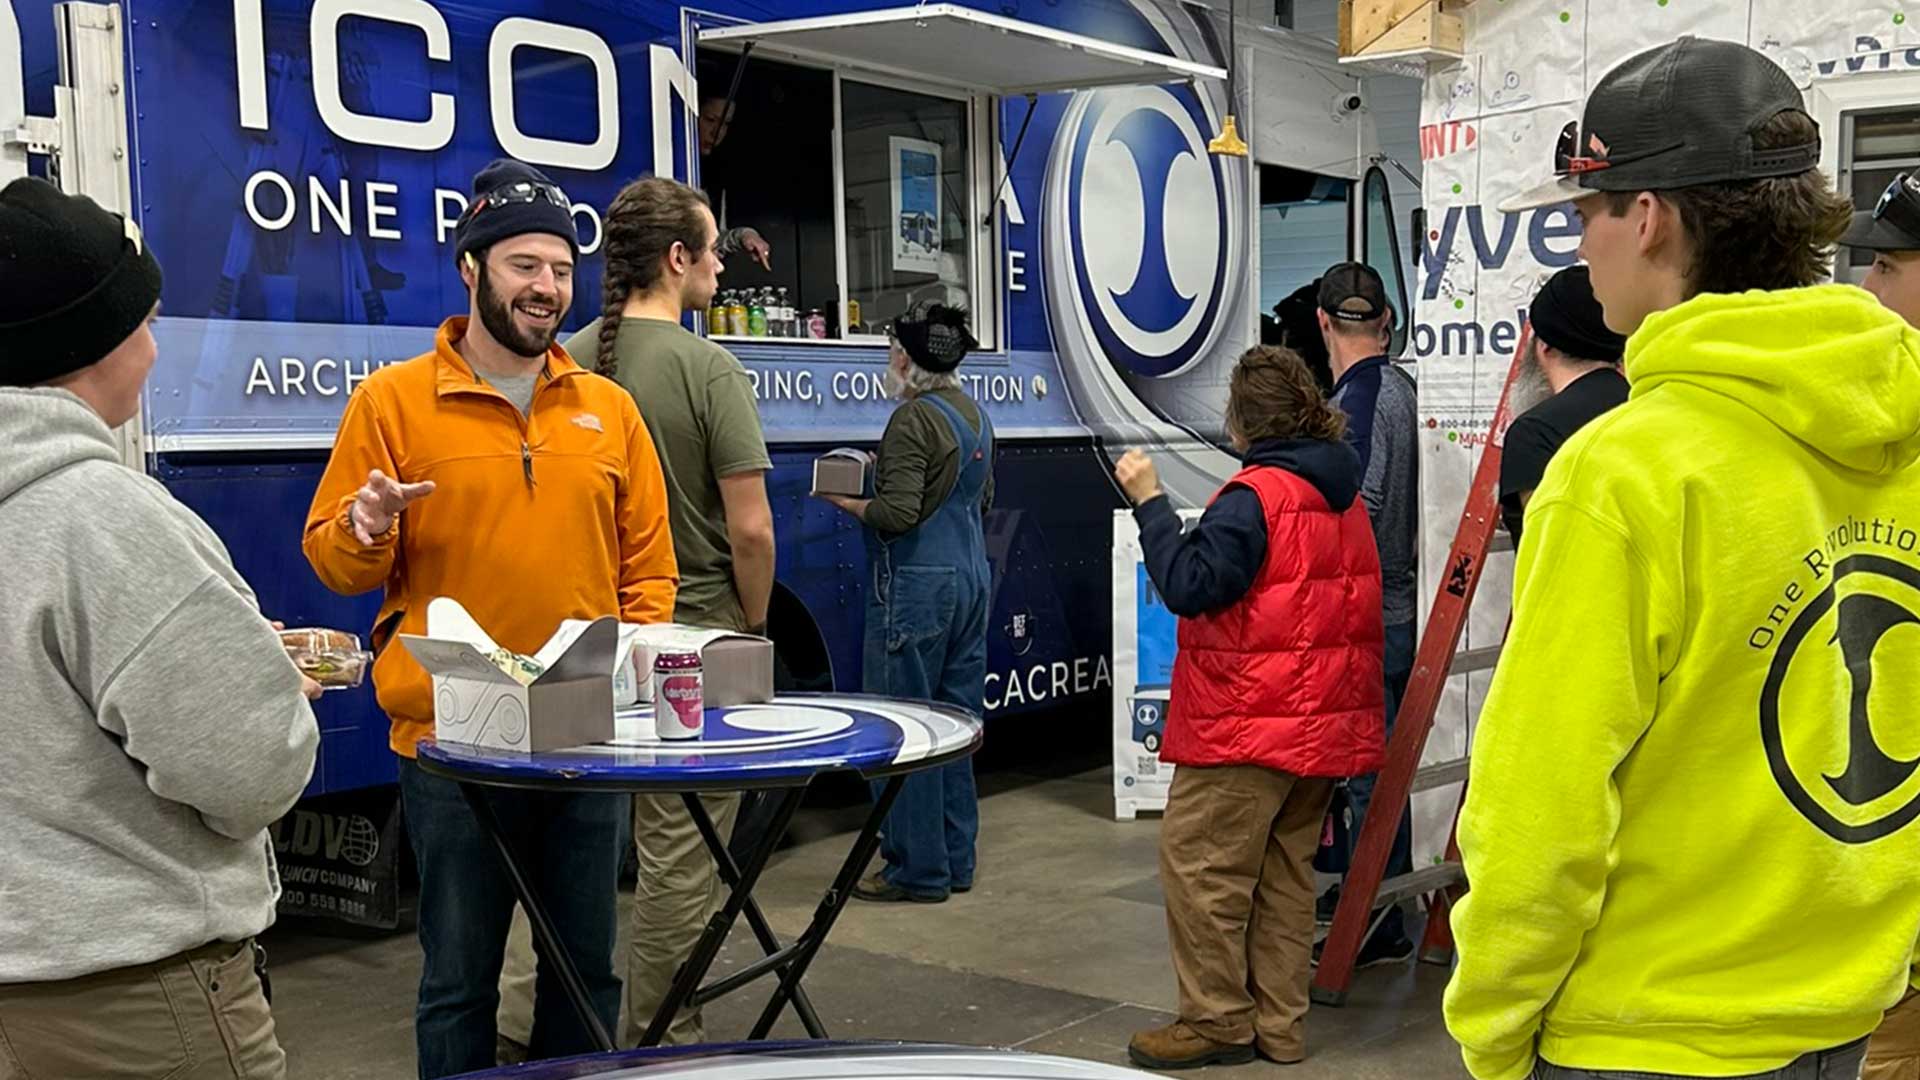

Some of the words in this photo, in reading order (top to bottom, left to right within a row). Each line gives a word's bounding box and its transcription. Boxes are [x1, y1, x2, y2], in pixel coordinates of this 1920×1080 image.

[244, 170, 402, 240] ONE
[1415, 310, 1528, 357] ome
[246, 357, 396, 396] ARCH
[1459, 432, 1487, 445] MAD
[1748, 581, 1805, 650] One
[279, 864, 320, 885] YNCH
[320, 869, 377, 896] COMPANY
